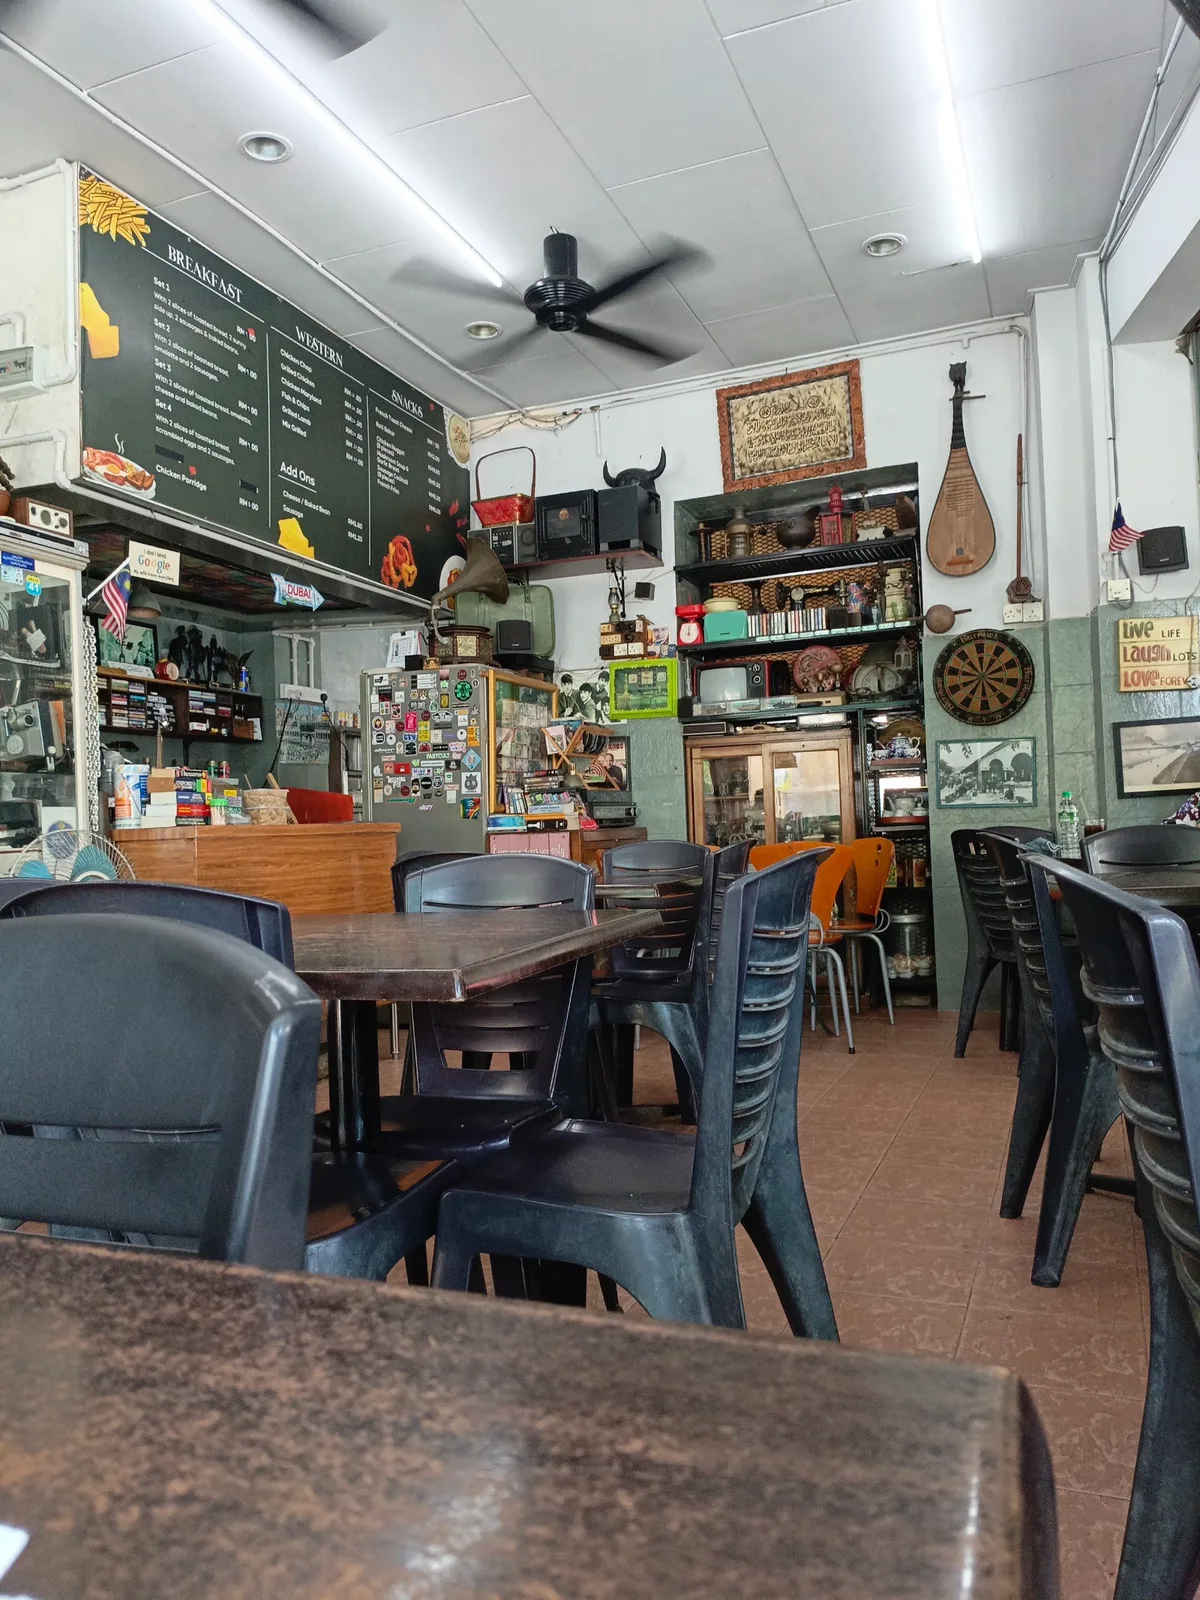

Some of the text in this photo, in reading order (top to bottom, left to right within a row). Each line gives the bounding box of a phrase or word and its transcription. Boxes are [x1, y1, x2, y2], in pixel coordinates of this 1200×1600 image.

[168, 244, 242, 303] BREAKFAST
[154, 277, 170, 292] Set 1
[154, 291, 168, 304] With
[172, 303, 186, 314] slices
[193, 314, 212, 330] toasted
[233, 337, 246, 350] sunny
[154, 304, 165, 314] side
[179, 318, 204, 334] sausages
[208, 333, 224, 346] baked
[154, 318, 170, 332] Set 2
[154, 332, 168, 344] With
[172, 342, 186, 354] slices
[194, 354, 214, 368] toasted
[154, 345, 178, 361] omelette
[179, 358, 190, 366] and
[296, 326, 343, 367] WESTERN
[154, 358, 172, 372] Set 3
[280, 348, 312, 374] Chicken Chop
[280, 362, 316, 388] Grilled Chicken
[154, 372, 168, 384] With
[173, 382, 188, 394] slices
[195, 392, 214, 406] toasted
[154, 386, 174, 398] cheese
[175, 394, 186, 404] and
[186, 398, 202, 411] baked
[280, 376, 322, 405] Chicken Maryland
[155, 398, 166, 410] Set
[282, 390, 292, 402] Fish
[296, 399, 310, 412] Chips
[392, 390, 424, 418] SNACKS
[282, 405, 312, 426] Grilled Lamb
[375, 406, 412, 434] French Toast Cheese
[155, 413, 169, 424] With
[174, 422, 188, 434] slices
[195, 432, 214, 446] toasted
[282, 420, 306, 437] Mix Grilled
[384, 426, 395, 436] Bakar
[156, 426, 184, 442] scrambled
[184, 438, 197, 449] eggs
[197, 445, 207, 453] and
[376, 436, 405, 456] Chicken Nugget
[376, 450, 396, 465] Mushroom
[396, 460, 406, 470] Soup
[376, 456, 400, 473] Garlic Bread
[156, 464, 208, 492] Chicken Porridge
[280, 462, 316, 486] Add Ons
[376, 464, 408, 486] Sausage Cocktail
[377, 478, 400, 494] French Fries
[282, 490, 301, 504] Cheese
[304, 499, 318, 510] Baked
[318, 506, 331, 516] Bean
[282, 504, 304, 518] Sausage
[138, 555, 170, 574] Google
[29, 584, 39, 592] 41
[288, 584, 310, 599] DUBAI
[1161, 628, 1180, 638] LIFE
[1123, 644, 1197, 662] Laugh LOTS
[1160, 676, 1189, 686] FOREV
